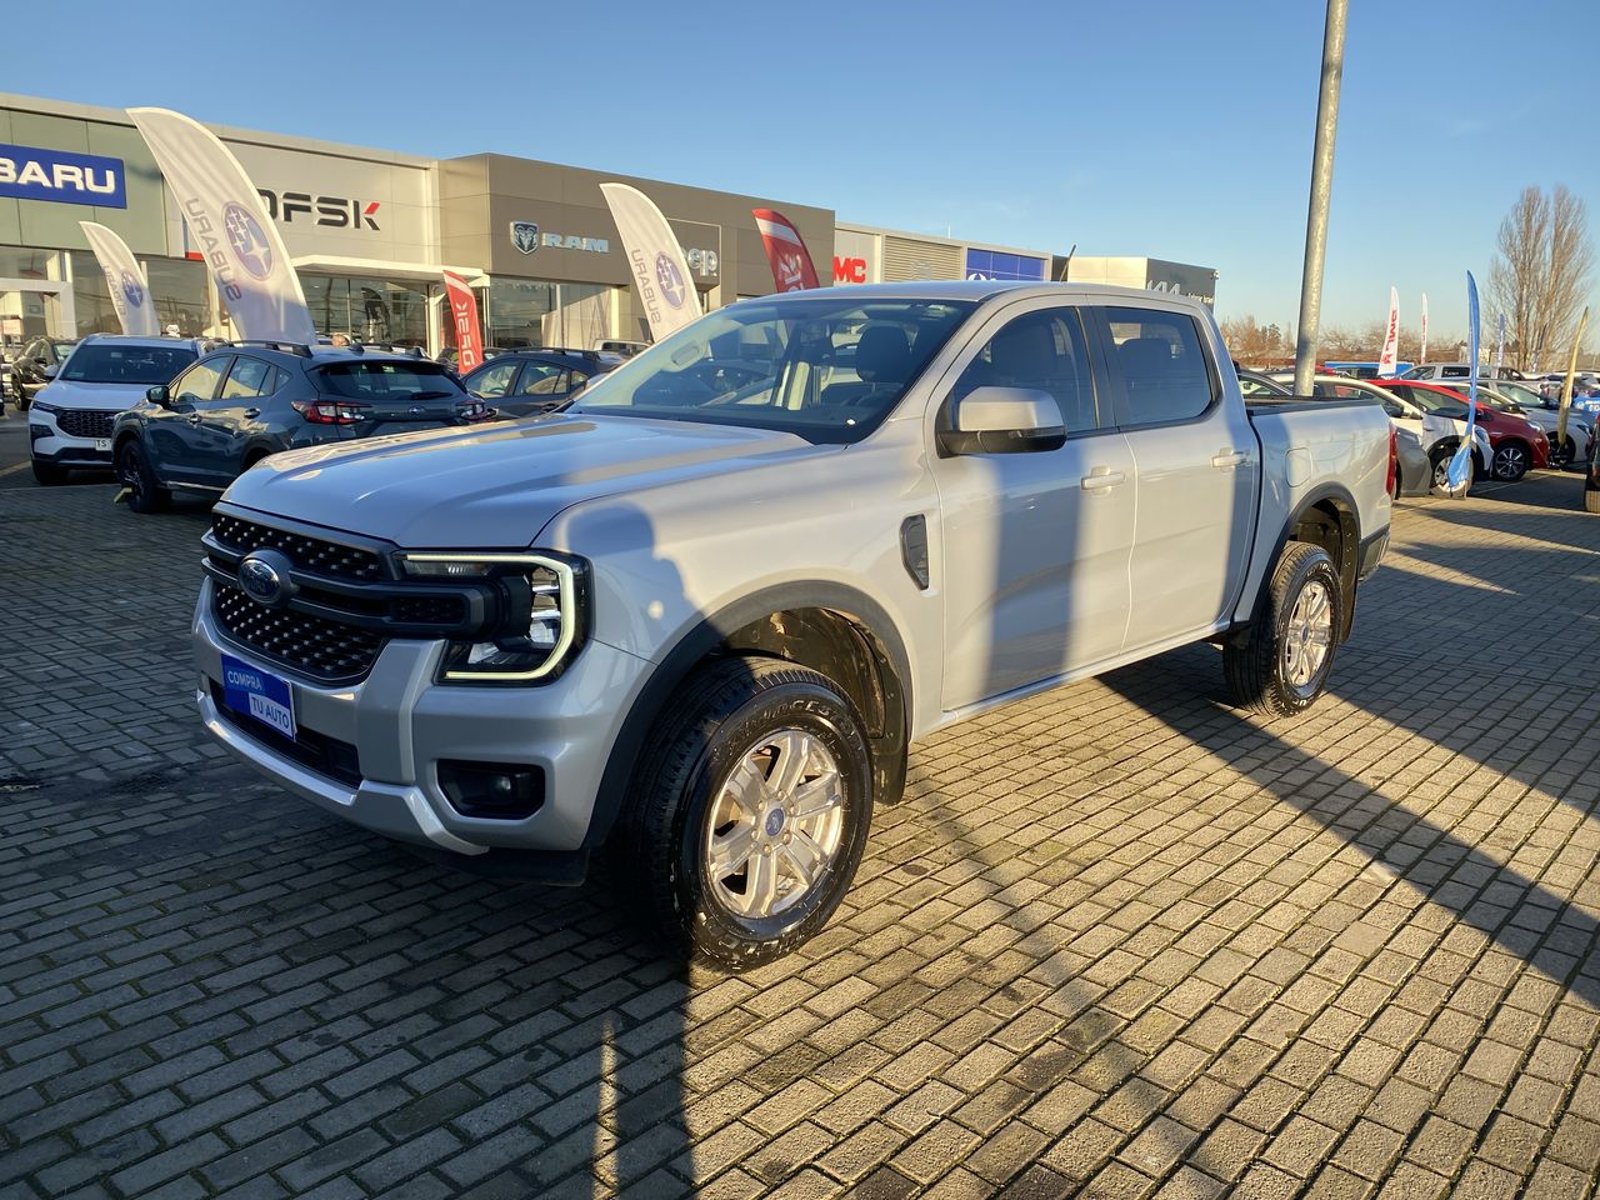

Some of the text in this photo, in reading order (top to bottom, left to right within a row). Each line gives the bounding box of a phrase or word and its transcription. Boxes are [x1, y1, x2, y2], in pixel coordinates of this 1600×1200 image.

[0, 157, 116, 194] BARU
[541, 232, 609, 253] RAM
[680, 246, 718, 277] ep
[832, 256, 867, 284] MC
[228, 671, 262, 690] COMPRA
[252, 697, 289, 729] TU AUTO
